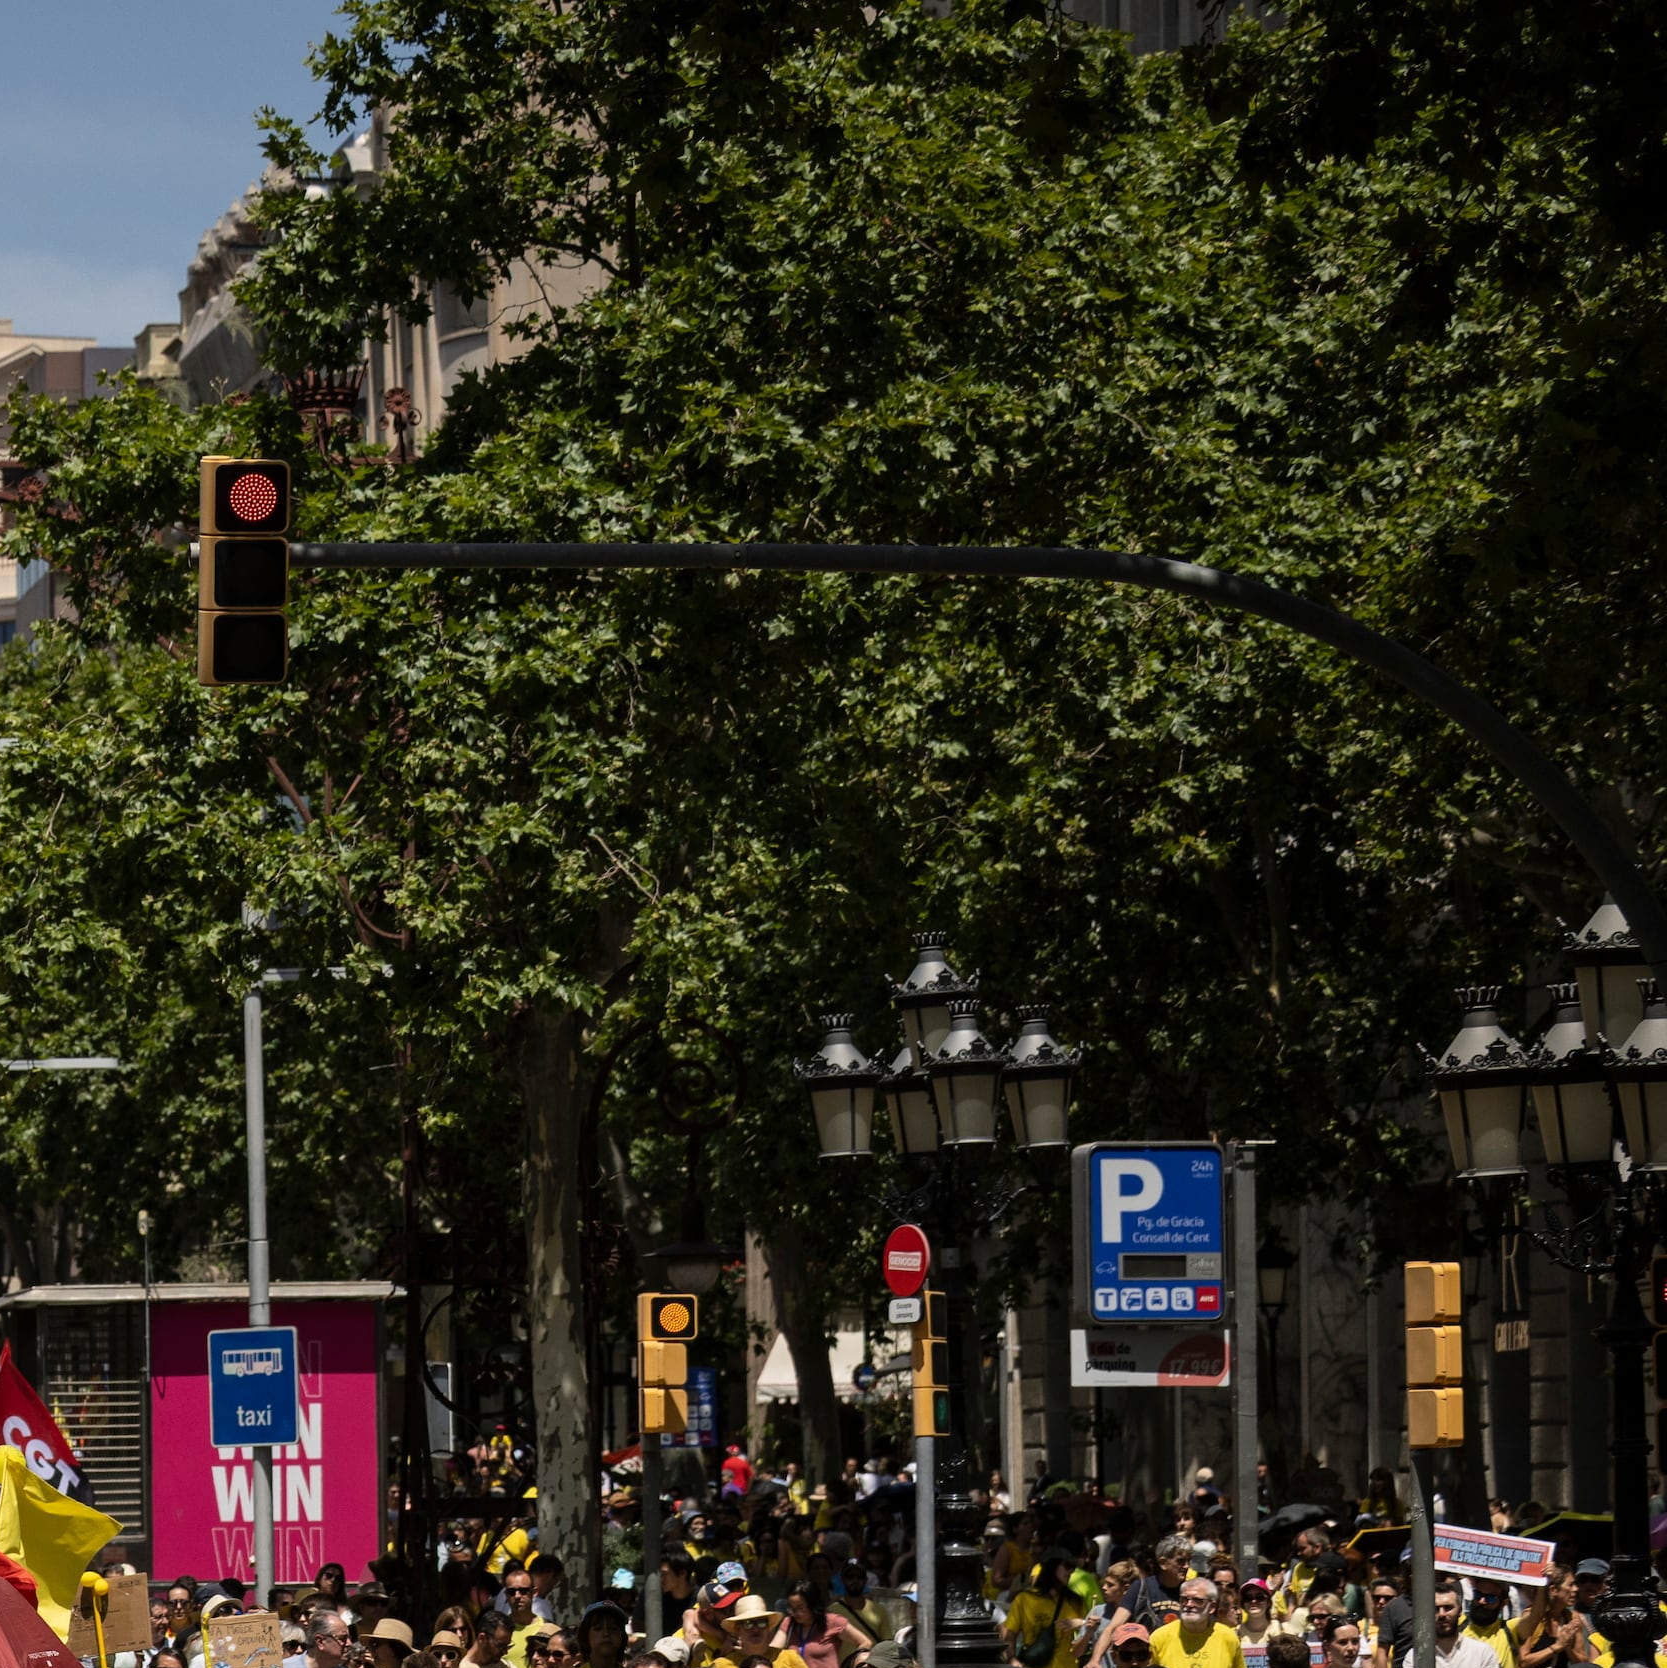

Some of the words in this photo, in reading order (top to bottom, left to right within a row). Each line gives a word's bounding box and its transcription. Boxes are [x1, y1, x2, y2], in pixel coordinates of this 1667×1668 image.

[1100, 1158, 1164, 1243] P
[1191, 1160, 1213, 1173] 24h
[1132, 1232, 1169, 1243] Consell
[1170, 1232, 1185, 1243] de
[1186, 1232, 1209, 1243] Cent
[1156, 1216, 1169, 1227] de
[237, 1405, 272, 1427] taxi
[2, 1414, 81, 1496] CGT
[212, 1465, 323, 1522] WIN
